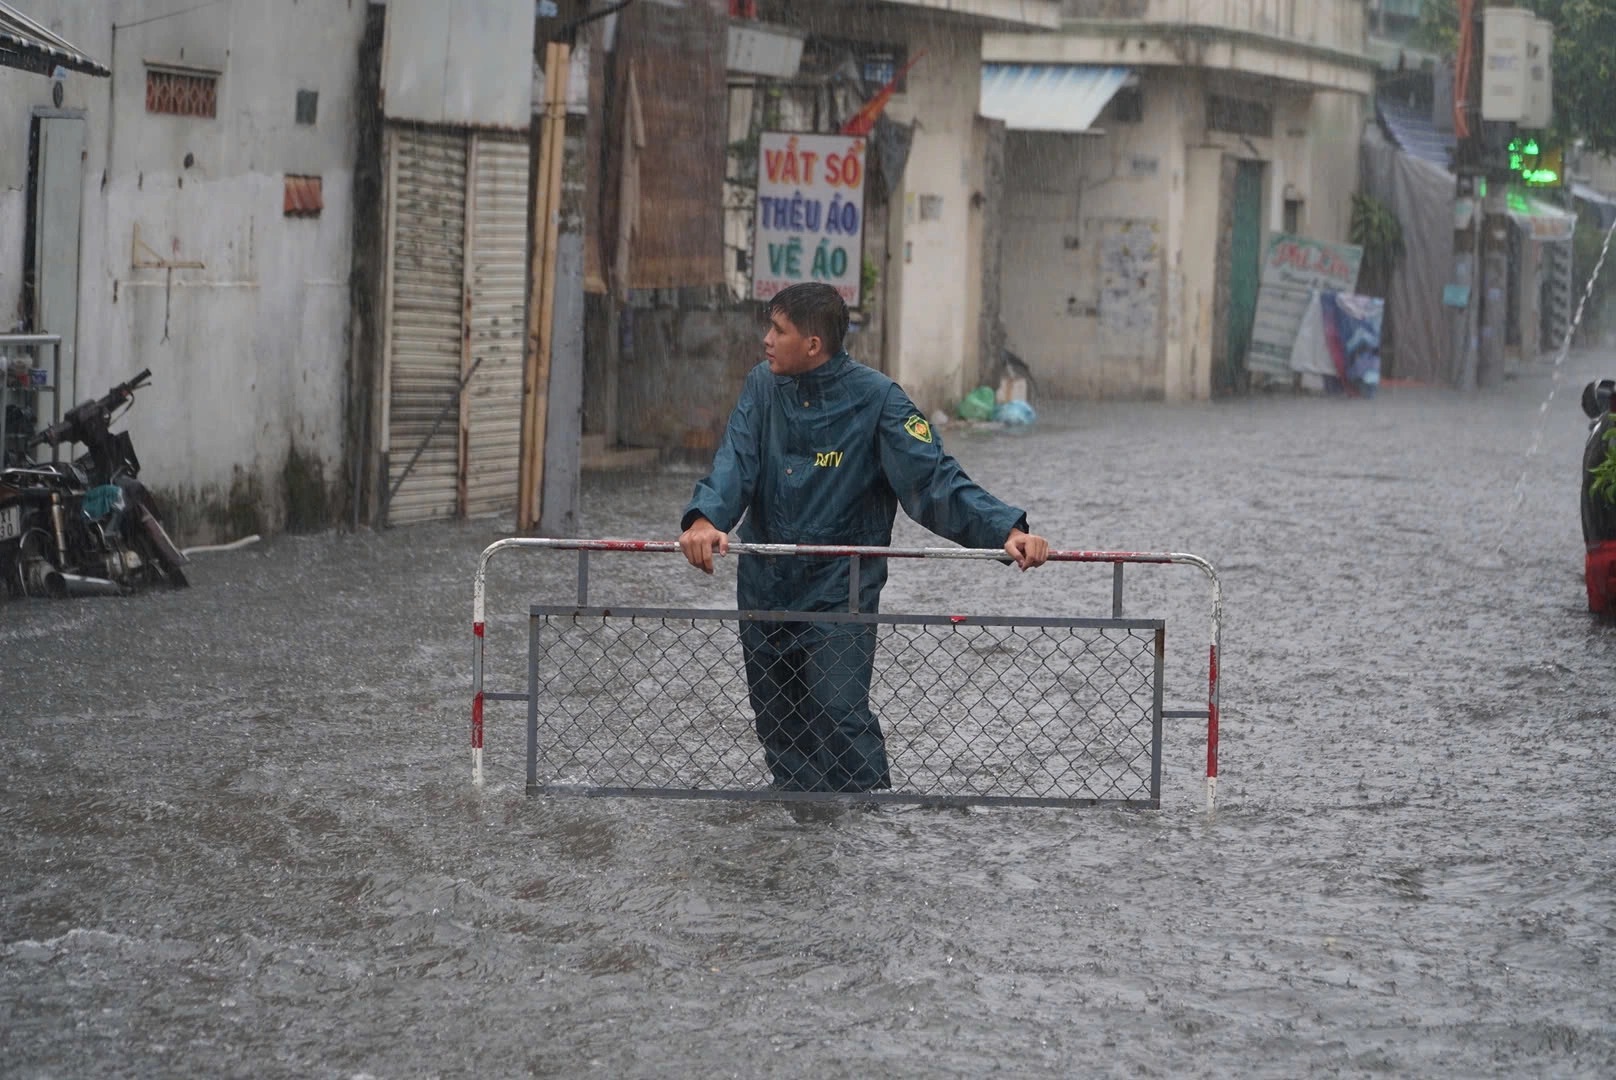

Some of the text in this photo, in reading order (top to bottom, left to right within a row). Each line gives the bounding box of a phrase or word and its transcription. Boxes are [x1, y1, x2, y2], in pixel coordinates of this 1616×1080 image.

[825, 139, 863, 189] SỔ
[759, 190, 860, 236] THÊU ÁO
[768, 237, 848, 280] VẼ ÁO
